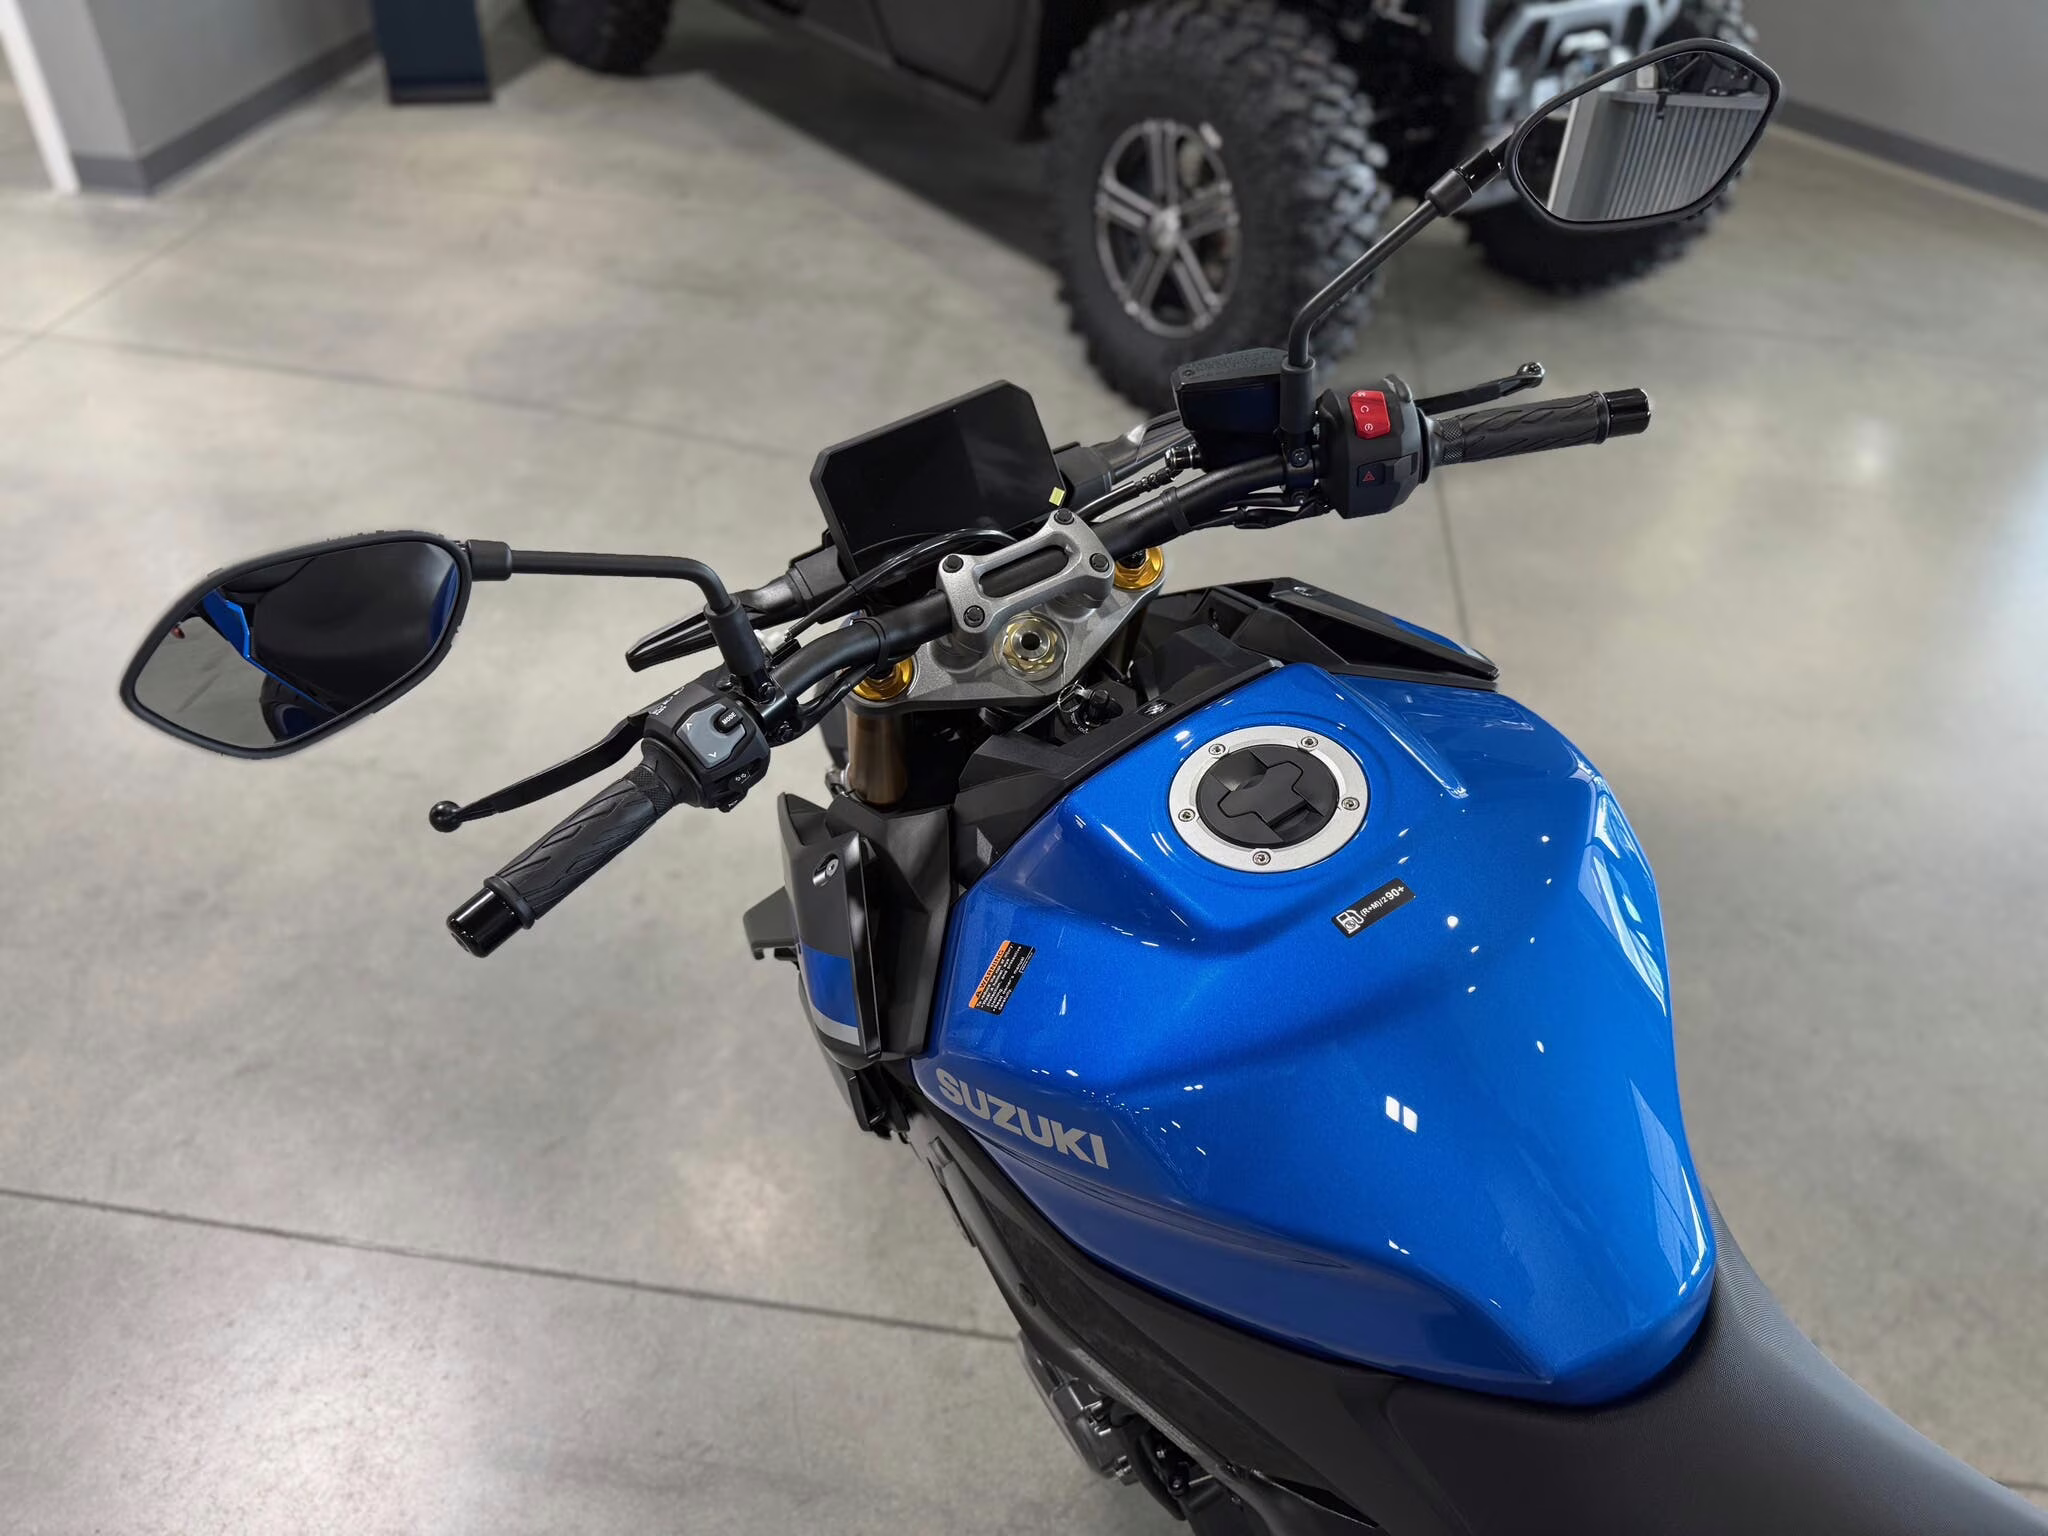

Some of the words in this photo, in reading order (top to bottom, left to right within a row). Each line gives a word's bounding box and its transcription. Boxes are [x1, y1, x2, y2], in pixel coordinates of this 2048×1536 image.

[721, 712, 736, 724] MODE
[980, 949, 1004, 989] WARNING
[935, 1067, 1109, 1169] SUZUKI
